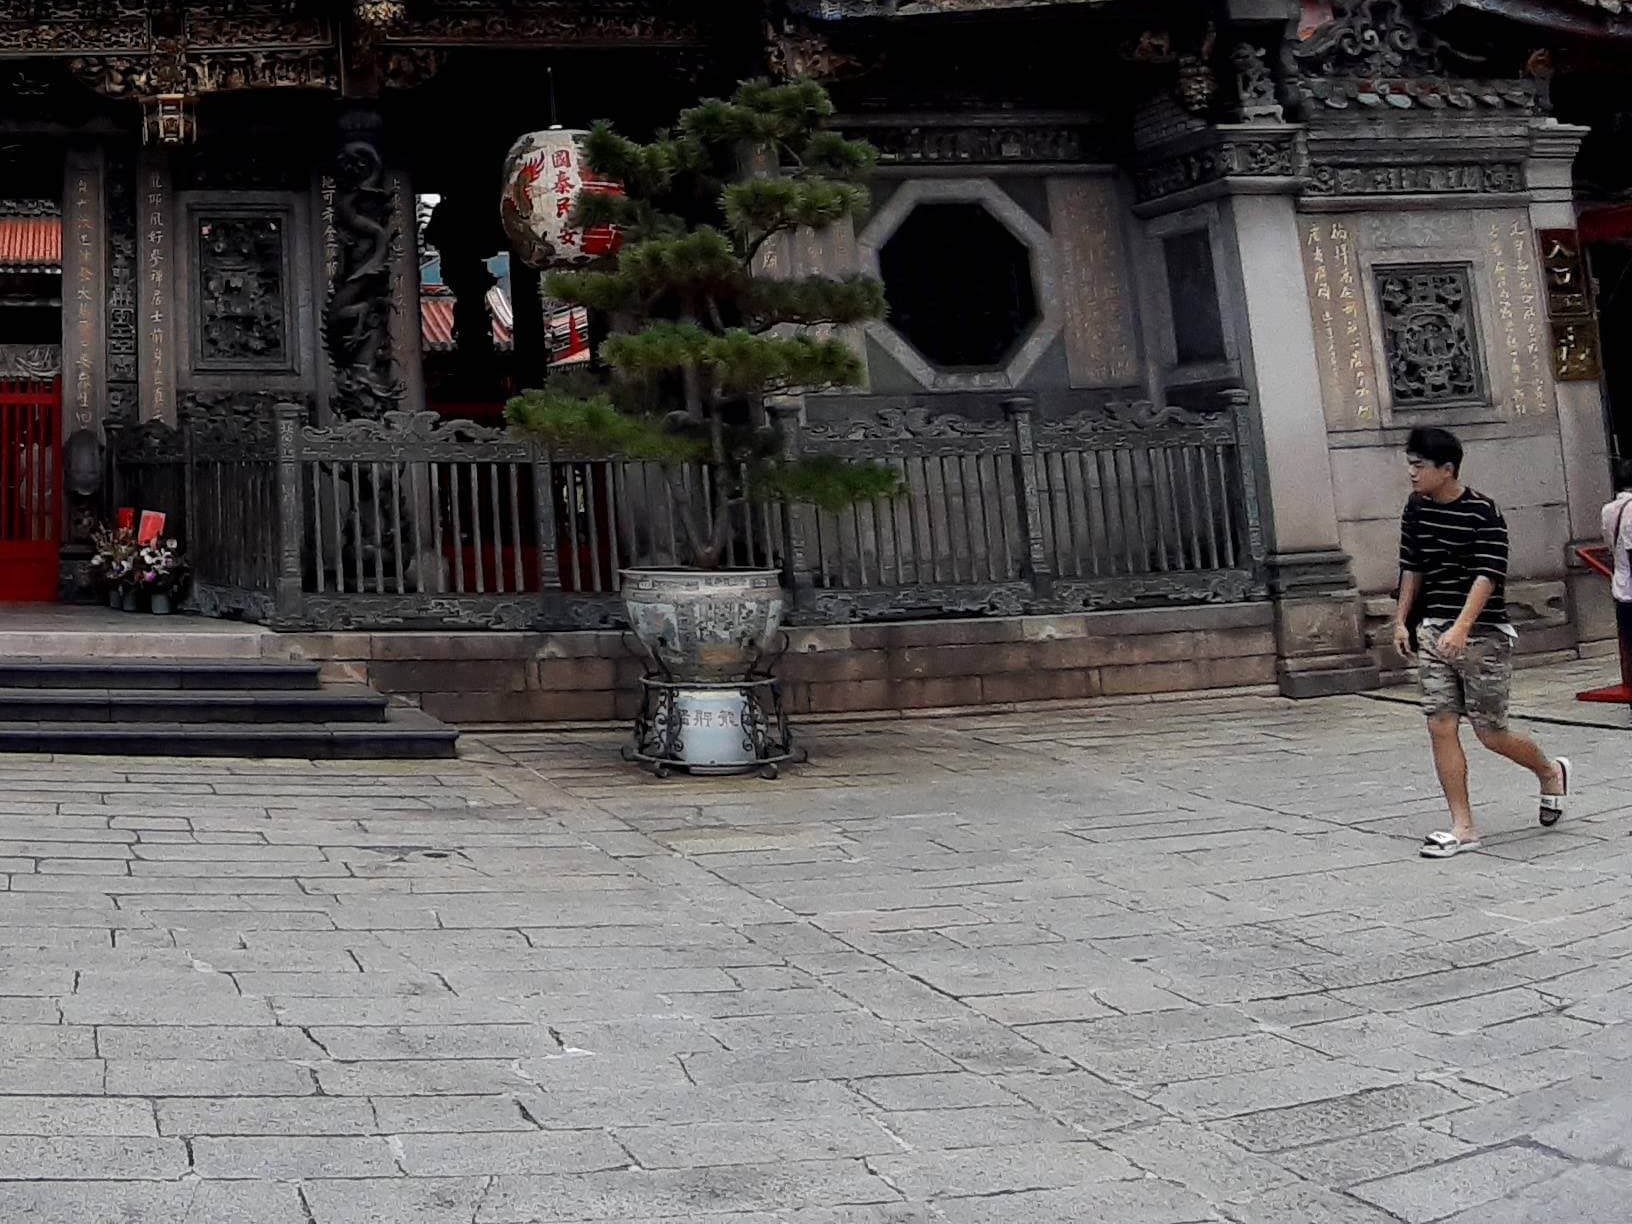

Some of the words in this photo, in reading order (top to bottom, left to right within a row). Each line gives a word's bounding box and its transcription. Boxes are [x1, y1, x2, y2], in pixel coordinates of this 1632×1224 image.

[550, 149, 578, 247] 國泰民安
[1547, 239, 1575, 285] 入口
